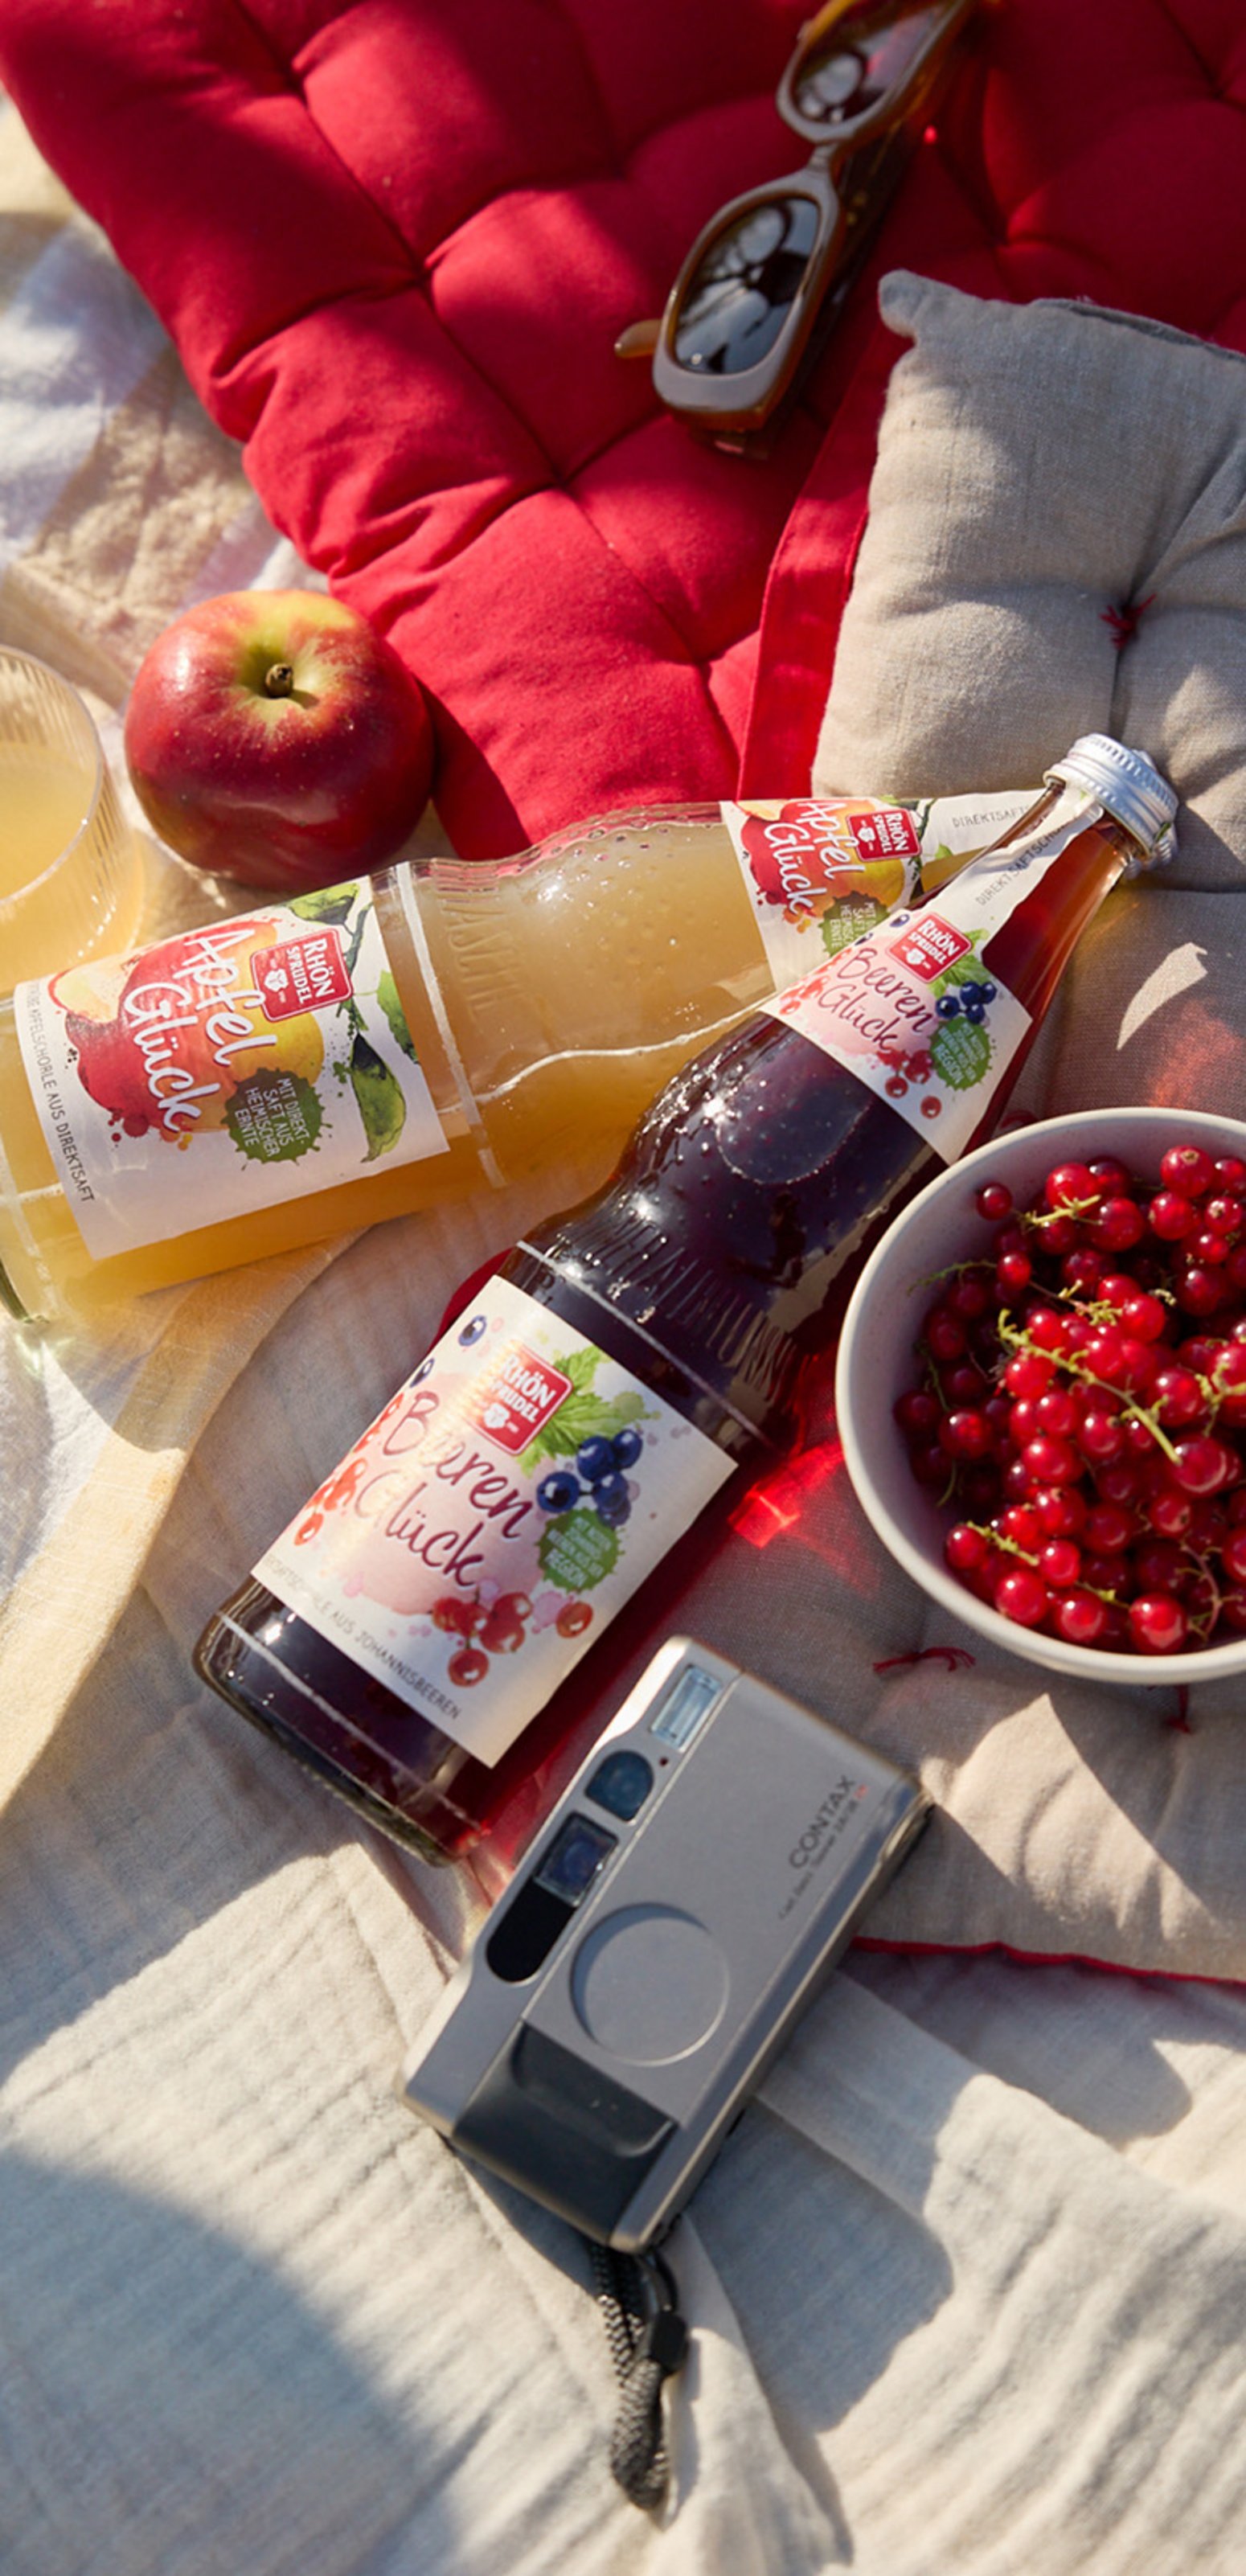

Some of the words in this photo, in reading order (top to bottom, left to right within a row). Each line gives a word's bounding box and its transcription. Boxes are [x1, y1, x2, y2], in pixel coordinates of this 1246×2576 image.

[795, 801, 865, 880] Apfel
[884, 813, 909, 851] RHÖN
[764, 822, 827, 915] Glück
[302, 938, 335, 998] RHÖN
[908, 932, 948, 965] SPRUDEL
[918, 919, 960, 957] RHÖN
[172, 929, 277, 1066] Apfel
[285, 946, 314, 1004] SPRUDEL
[837, 948, 934, 1032] Beeren
[818, 984, 900, 1054] Glück
[123, 982, 221, 1132] Glück
[47, 1091, 65, 1121] AUS
[263, 1089, 285, 1119] SAFT
[274, 1122, 294, 1146] AUS
[277, 1078, 296, 1099] MIT
[235, 1109, 260, 1146] ERNTE
[245, 1087, 281, 1157] HEIMISCHER
[55, 1122, 96, 1202] DIREKTSAFT
[489, 1378, 541, 1423] PRUDEL
[498, 1354, 557, 1409] RHÖN
[332, 1606, 357, 1635] AUS
[355, 1627, 462, 1720] JOHANNISBEEREN
[789, 1774, 855, 1868] CONTAX
